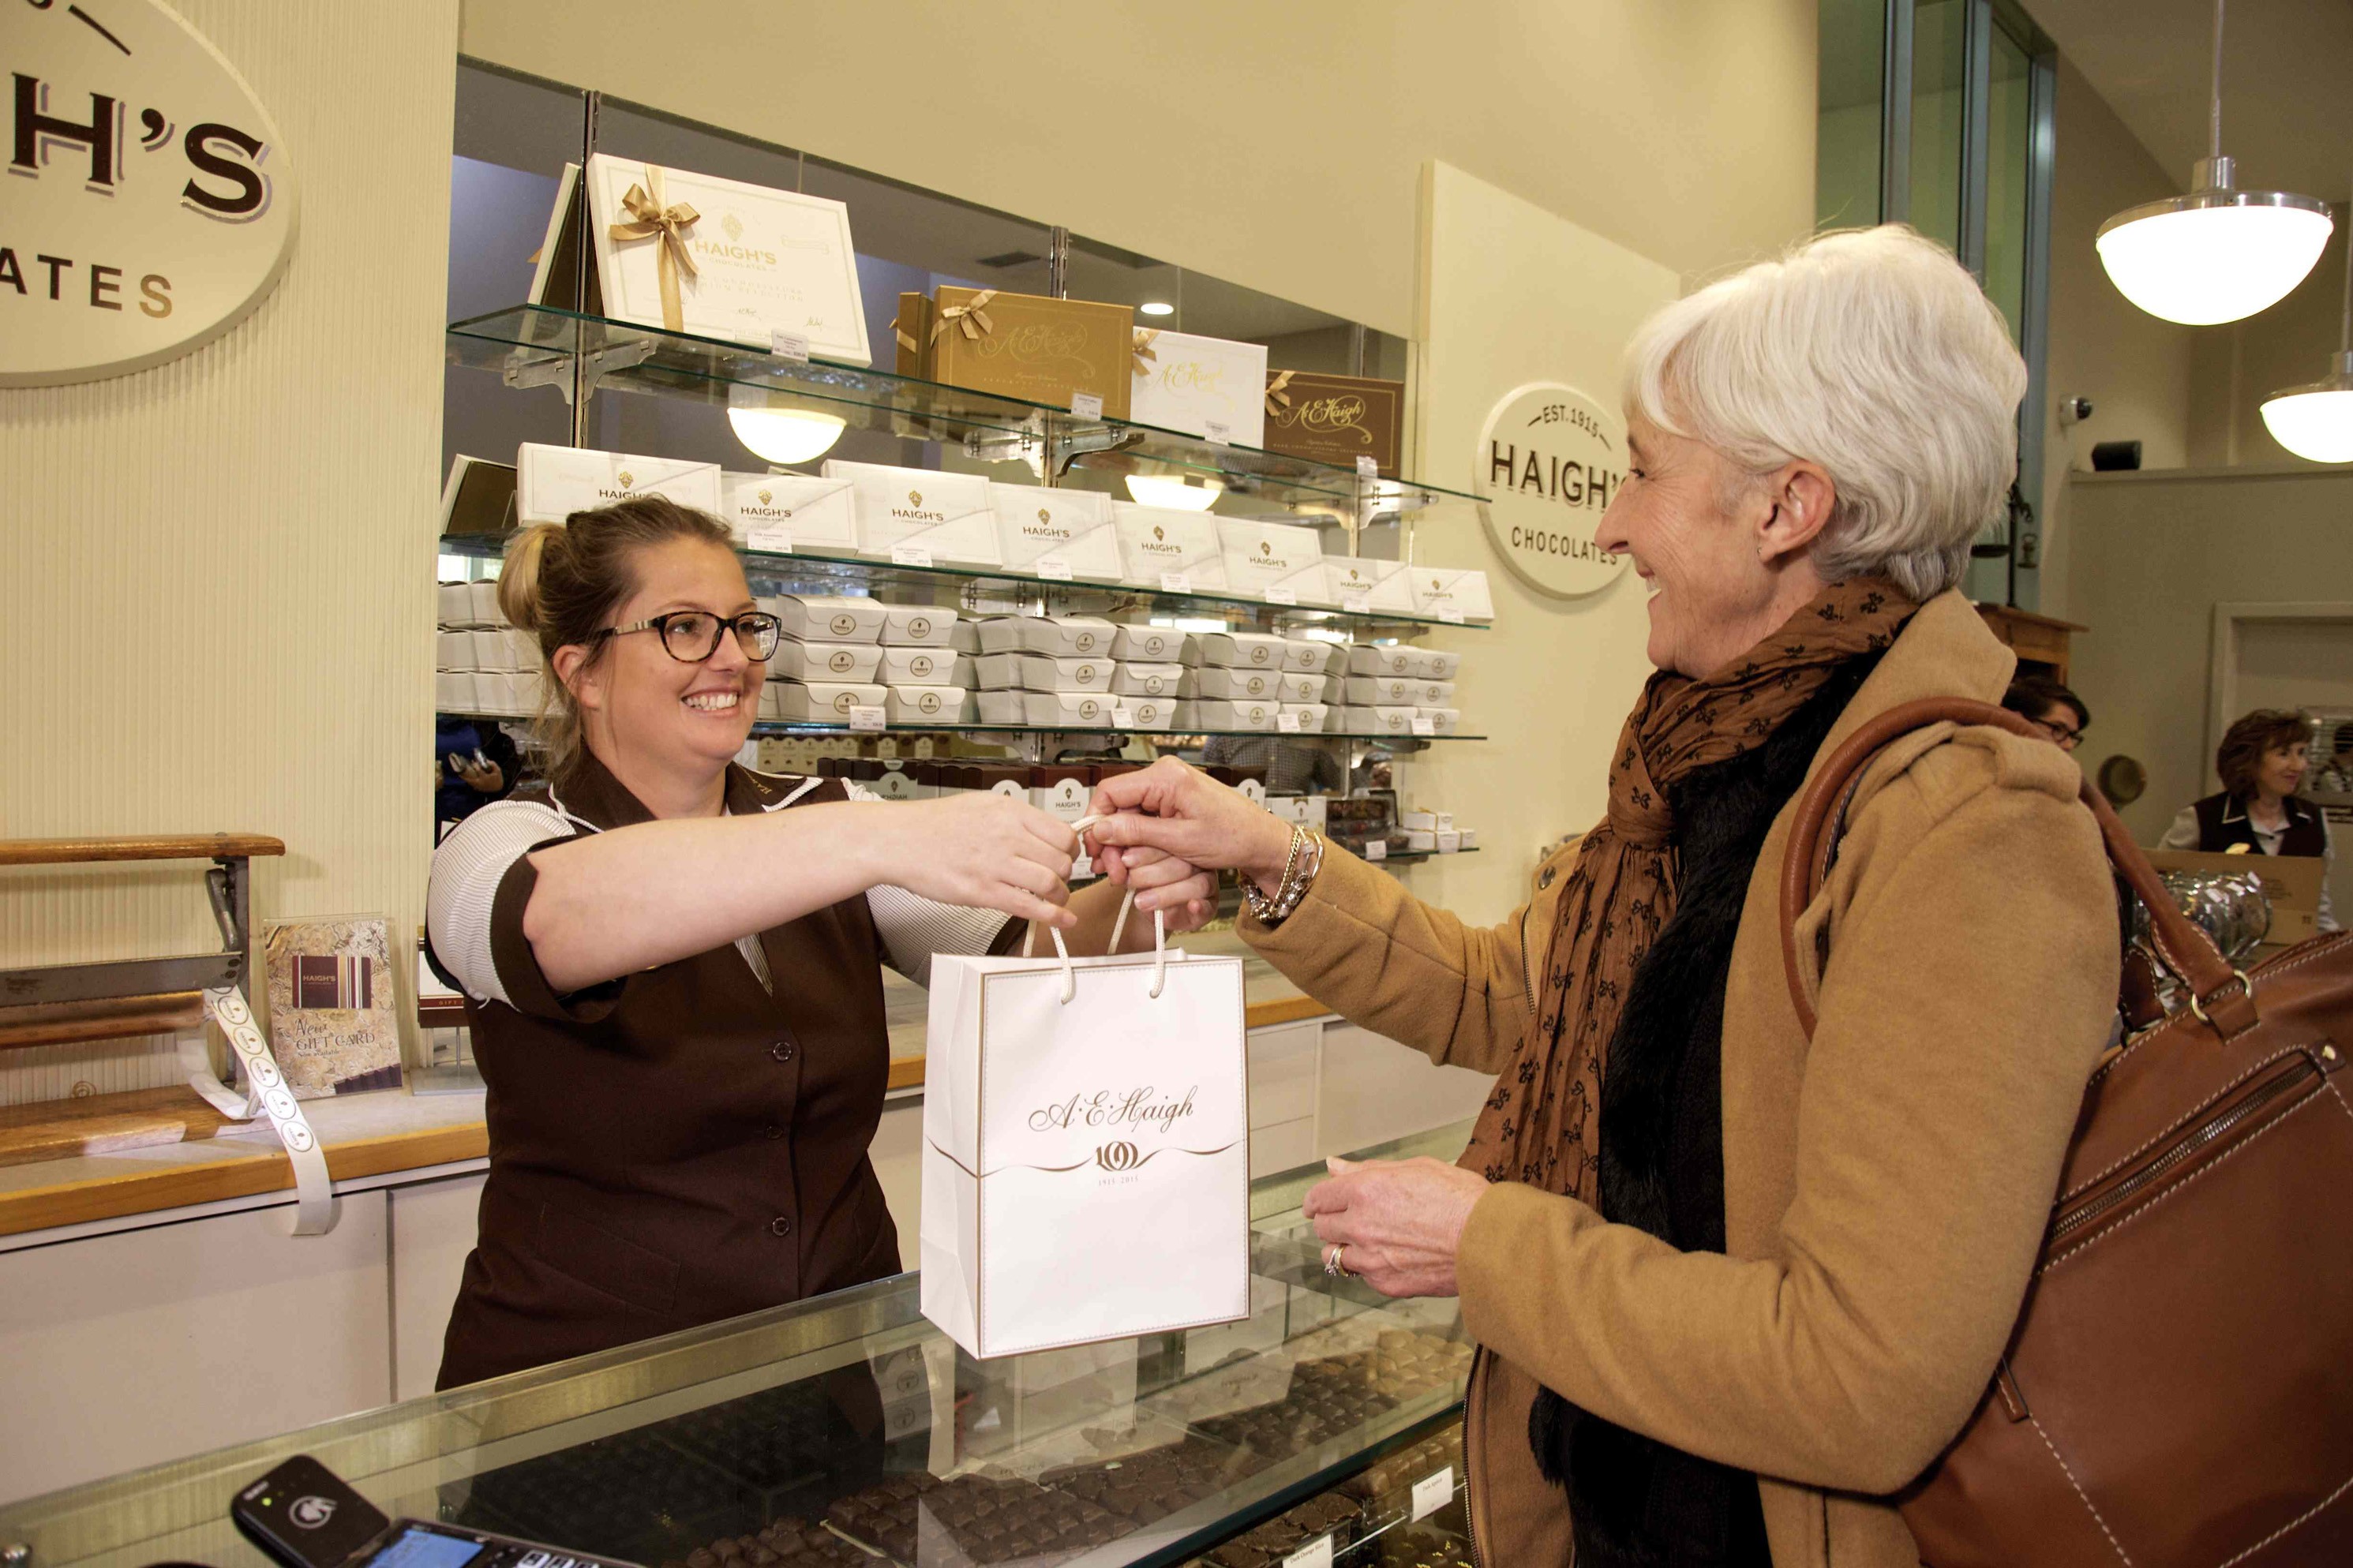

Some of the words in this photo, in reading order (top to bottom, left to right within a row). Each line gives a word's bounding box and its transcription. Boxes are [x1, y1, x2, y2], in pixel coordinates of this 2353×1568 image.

[695, 239, 777, 265] HAIGH'S
[1571, 407, 1598, 437] 1915
[1491, 440, 1626, 513] HAIGH'
[740, 507, 792, 518] HAIGH'S
[892, 508, 944, 521] HAIGH'S
[1022, 526, 1070, 538] HAIGH'S
[1141, 542, 1182, 553] HAIGH'S
[1249, 556, 1287, 567] HAIGH'S
[294, 1017, 328, 1036] New
[296, 1035, 328, 1051] GIFT
[335, 1032, 375, 1047] CARD
